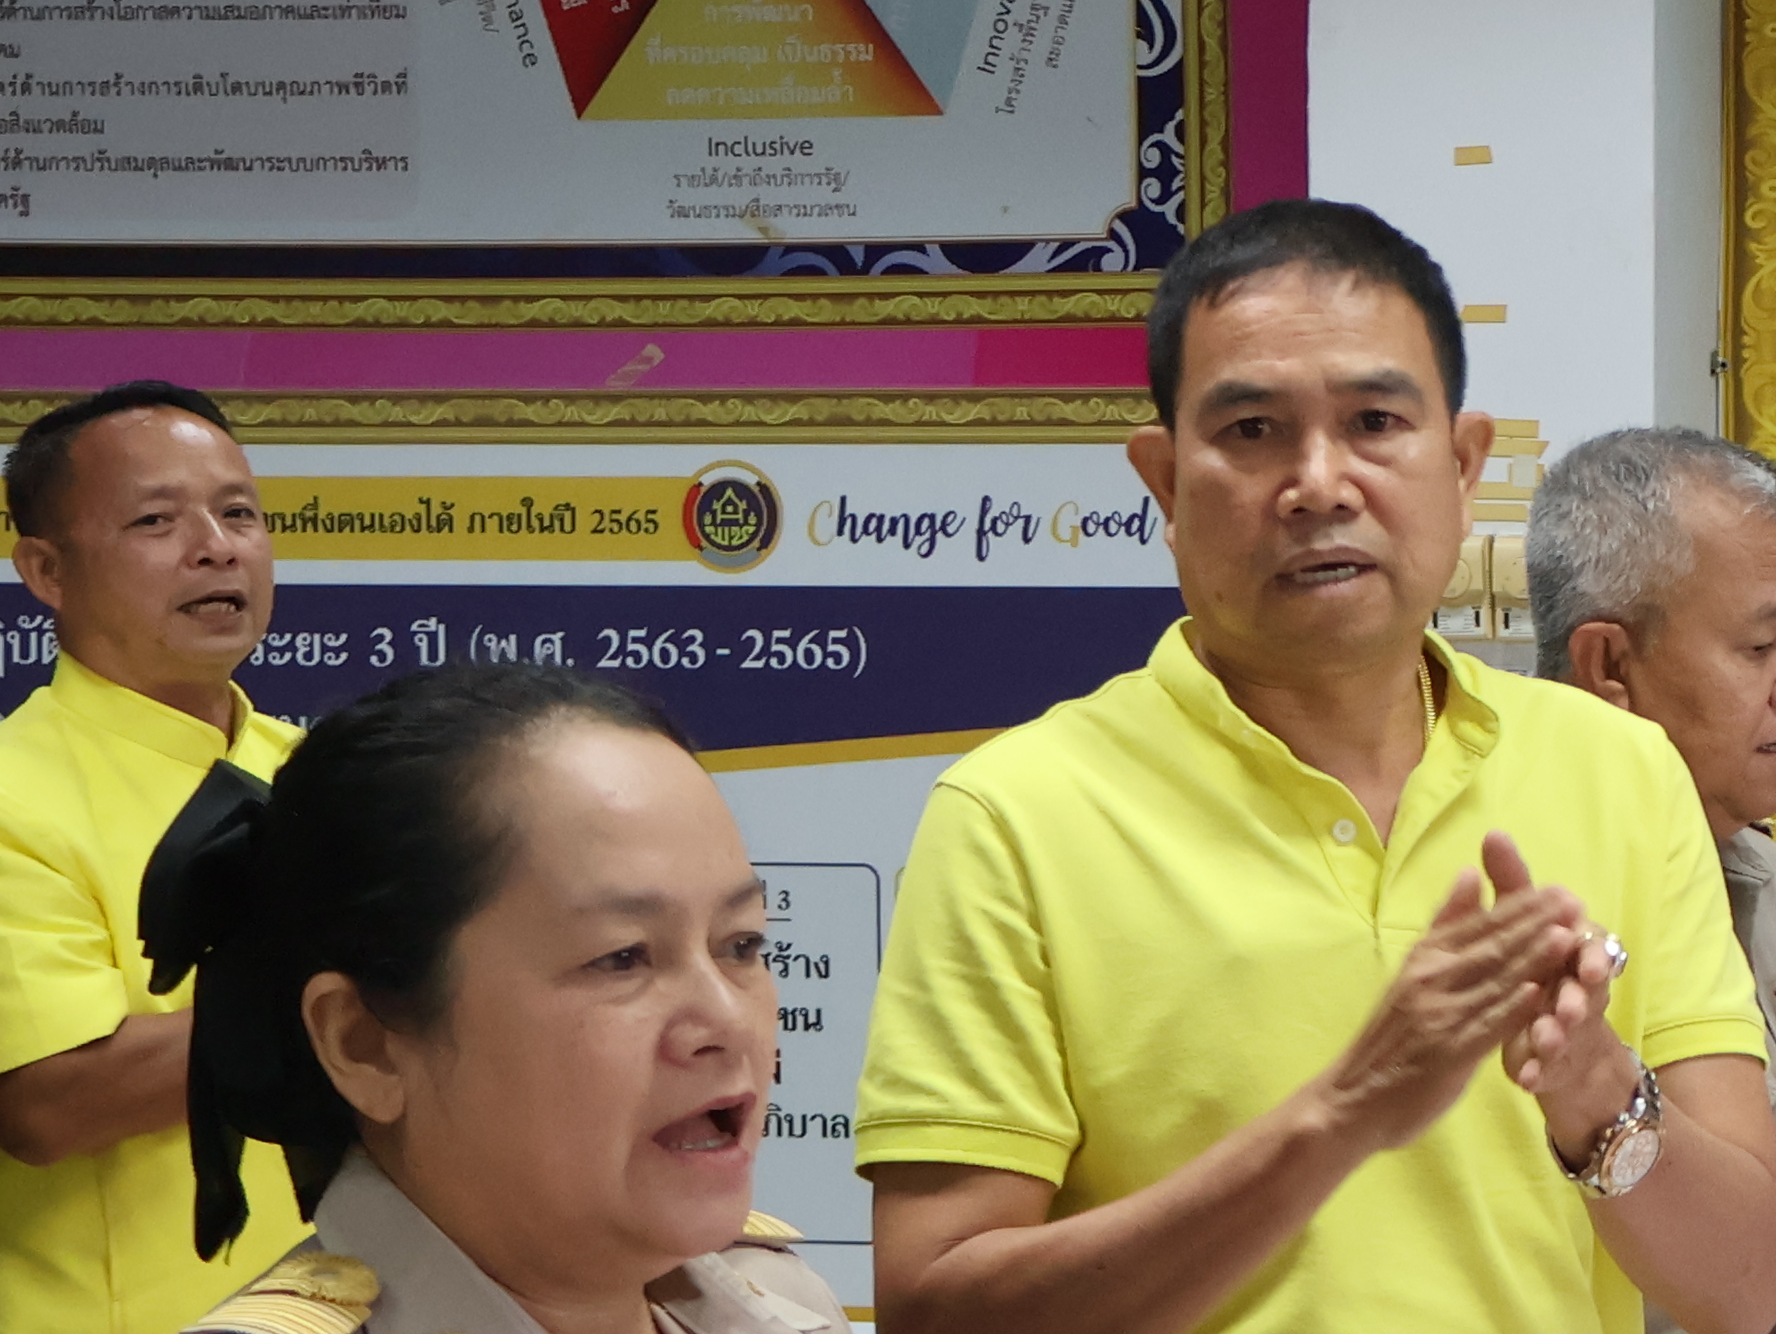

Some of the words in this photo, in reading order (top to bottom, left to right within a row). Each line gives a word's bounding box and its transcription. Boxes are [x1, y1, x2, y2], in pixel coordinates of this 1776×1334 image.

[707, 135, 814, 158] Inclusive
[466, 496, 577, 535] ภายในปี
[590, 508, 660, 536] 2565
[807, 494, 966, 559] Change
[974, 495, 1040, 562] for
[1049, 495, 1157, 549] Good
[369, 627, 397, 668] 3
[409, 616, 448, 667] ปี
[467, 623, 577, 669] (พ.ศ.
